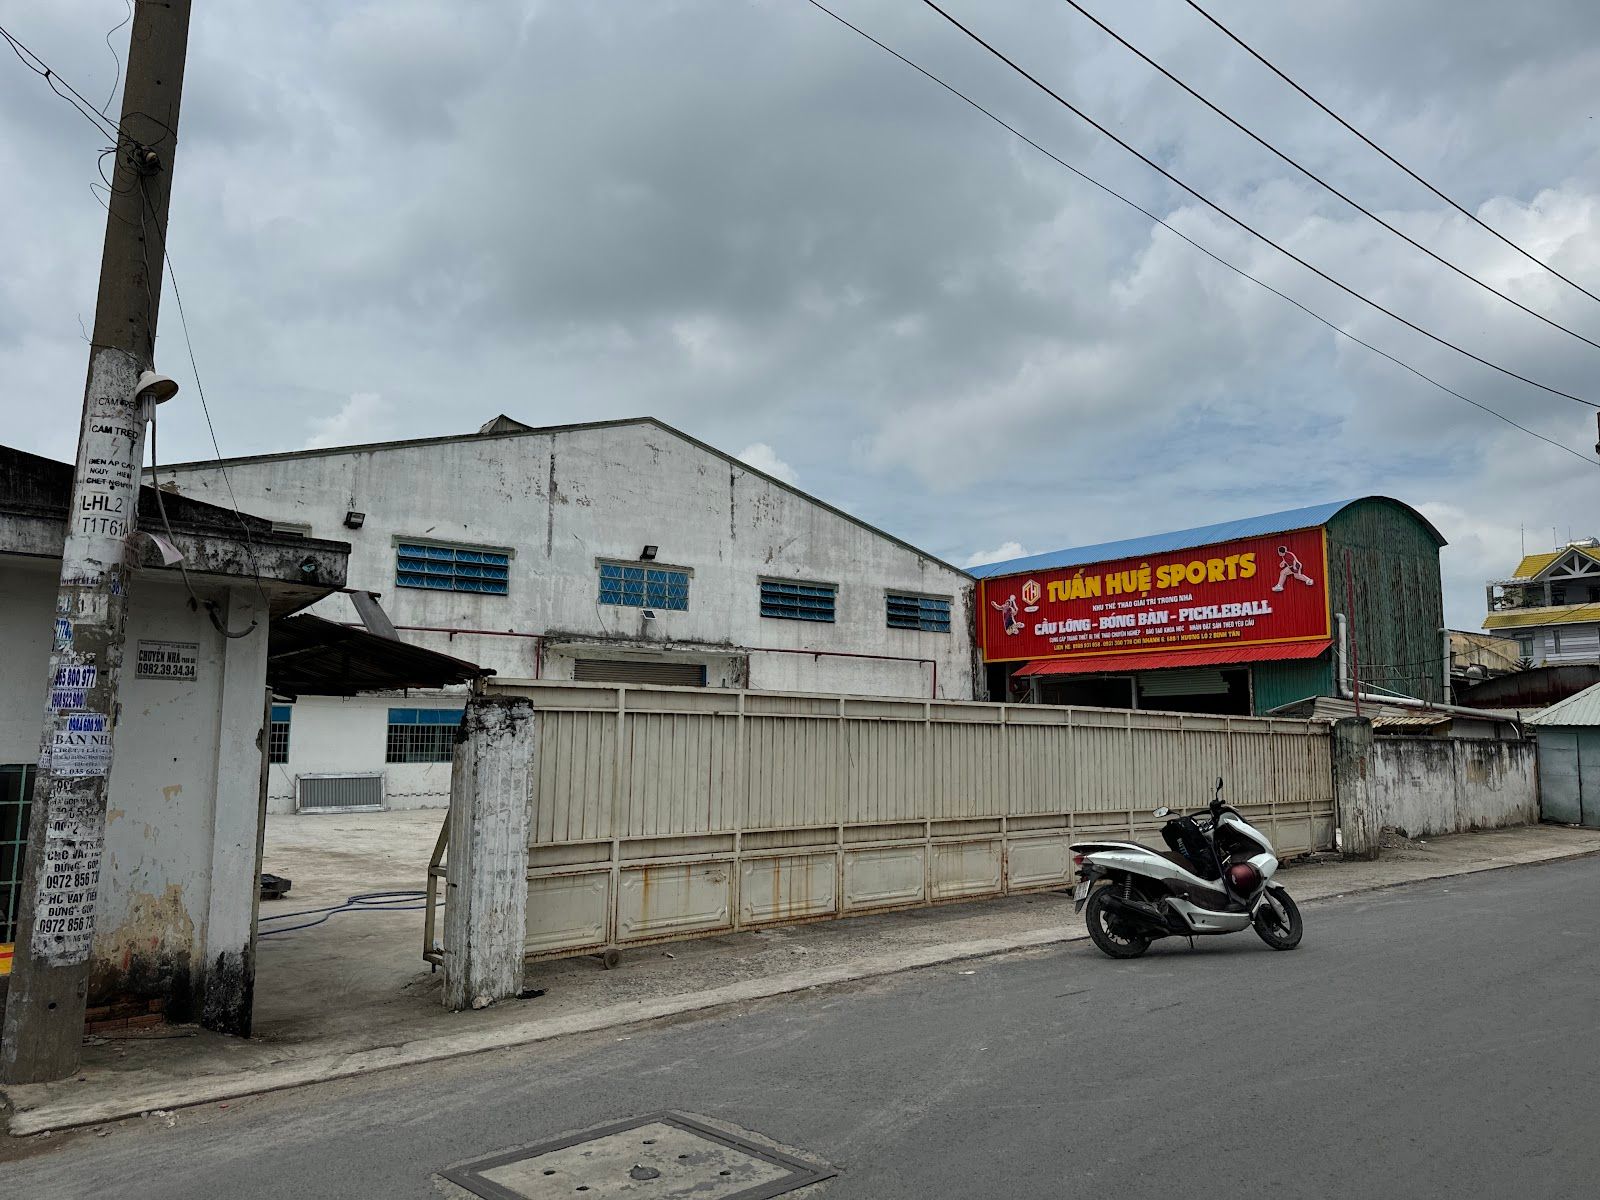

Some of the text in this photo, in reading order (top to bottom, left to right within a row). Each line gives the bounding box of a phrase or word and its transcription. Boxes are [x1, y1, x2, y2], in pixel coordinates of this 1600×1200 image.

[1047, 552, 1256, 602] TUẤN HUỆ SPORTS
[1092, 604, 1104, 612] KHU
[1157, 595, 1179, 604] TRONG
[1035, 618, 1057, 635] CẦU
[1059, 618, 1092, 633] LÔNG
[1099, 612, 1136, 629] BÓNG
[1138, 608, 1169, 626] BÀN
[1179, 600, 1273, 623] PICKLEBALL
[55, 732, 88, 745] BÁN
[46, 873, 72, 889] 0972
[74, 872, 90, 887] 856
[67, 917, 84, 932] 856
